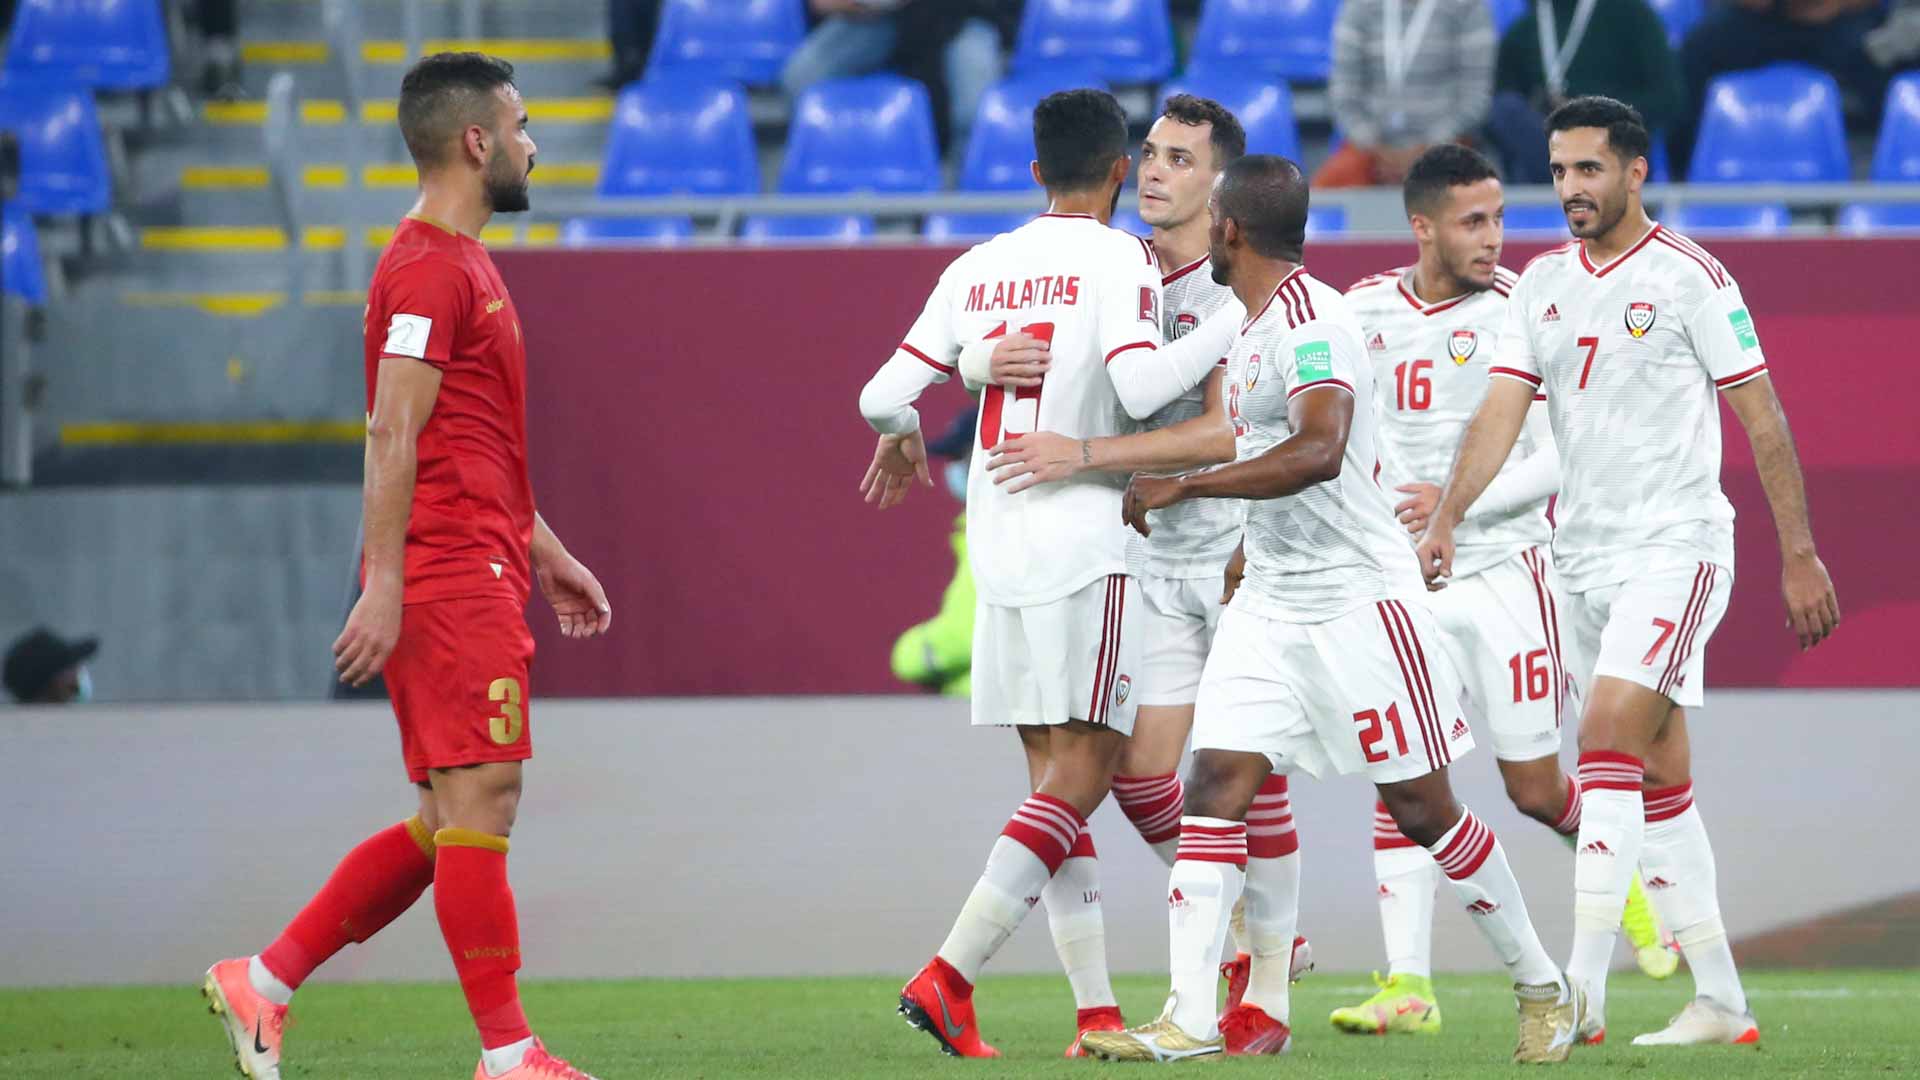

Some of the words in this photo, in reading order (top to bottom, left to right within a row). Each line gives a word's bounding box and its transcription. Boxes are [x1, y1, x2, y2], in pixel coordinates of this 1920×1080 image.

[964, 275, 1080, 312] M.ALATTAS
[1394, 359, 1434, 411] 16
[1576, 336, 1599, 390] 7
[1641, 617, 1676, 666] 7
[1508, 647, 1549, 703] 16
[488, 677, 522, 745] 3
[1352, 701, 1410, 763] 21
